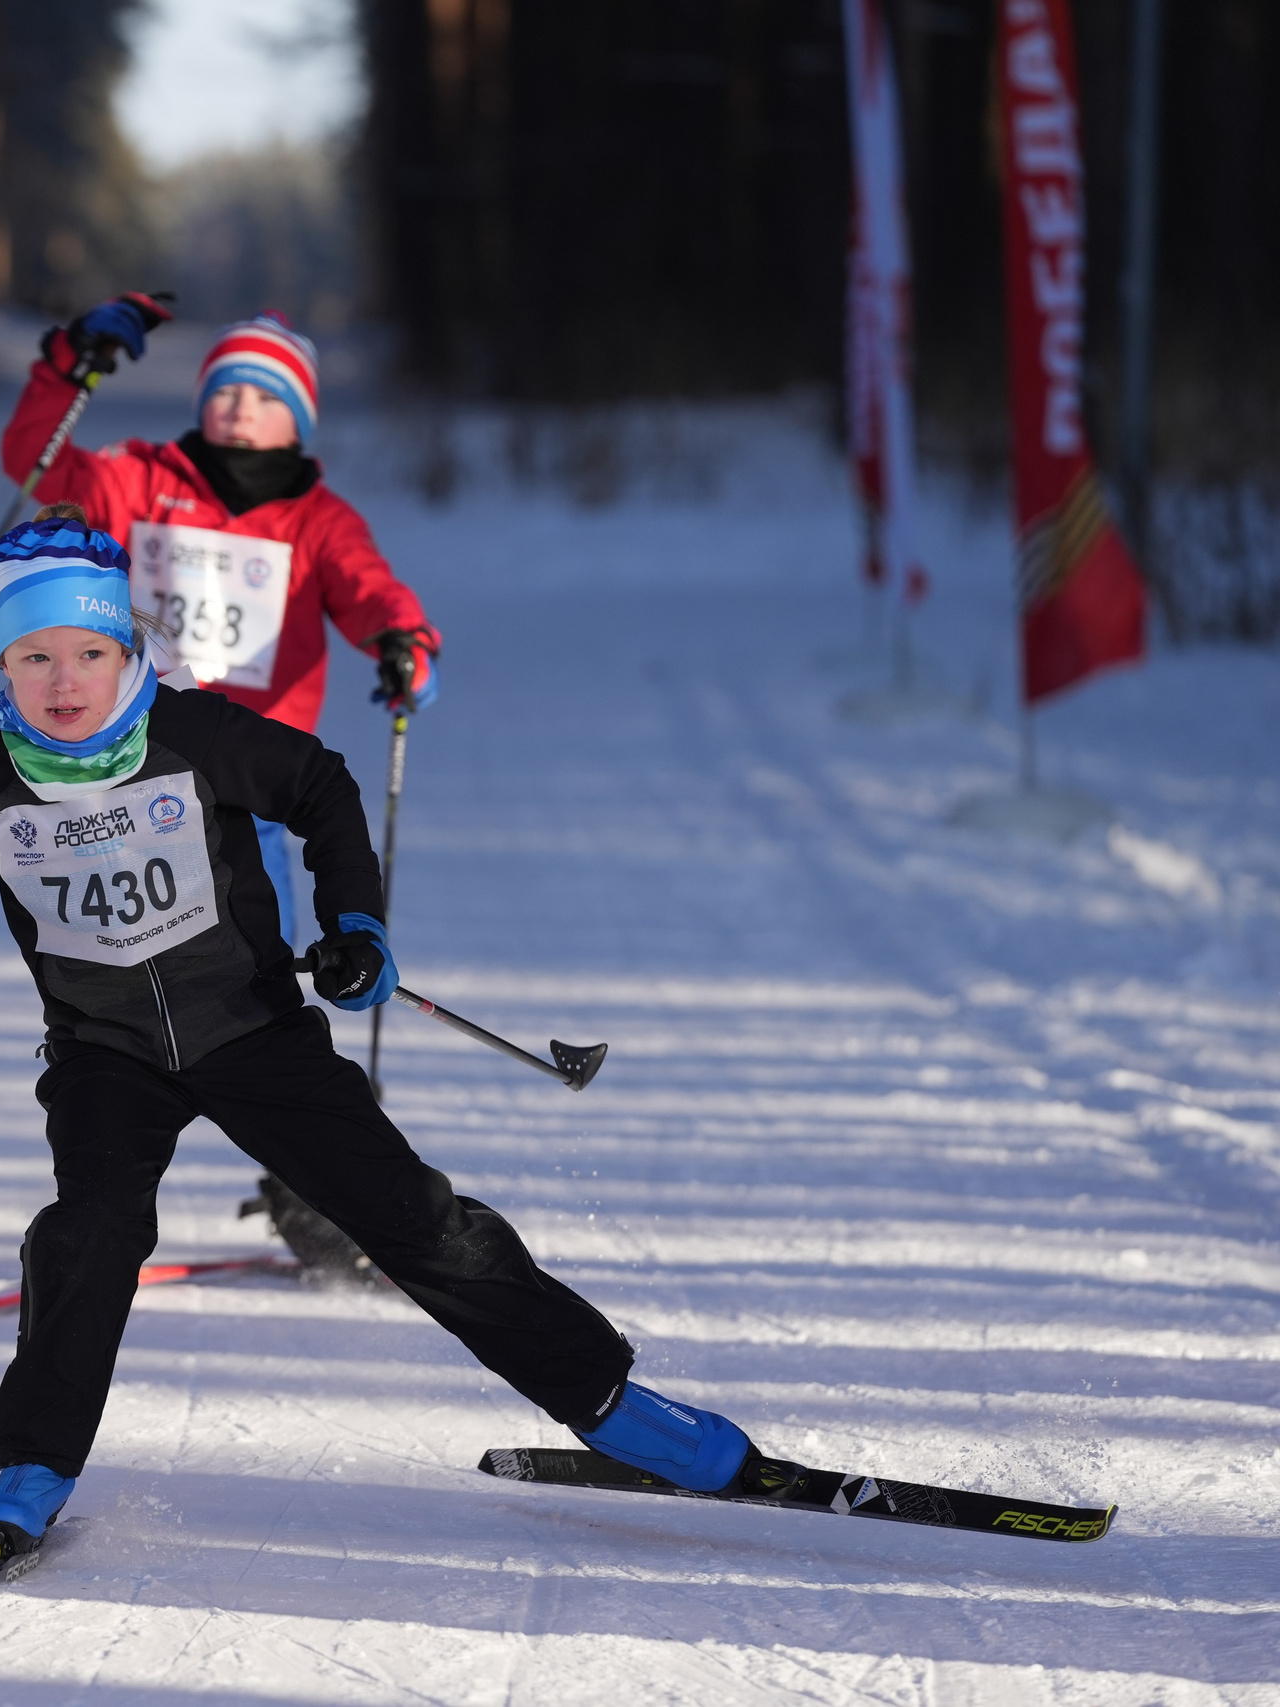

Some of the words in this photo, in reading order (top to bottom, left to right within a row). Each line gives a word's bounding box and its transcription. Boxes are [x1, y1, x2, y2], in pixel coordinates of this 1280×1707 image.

[152, 590, 243, 648] 7358
[54, 819, 136, 848] РОССИИ
[56, 806, 130, 834] ЛЫЖНЯ
[72, 836, 125, 858] 2025
[17, 859, 45, 867] РОССИИ
[40, 857, 177, 927] 7430
[96, 925, 164, 949] СВЕРДЛОВСКАЯ
[166, 905, 205, 930] ОБЛАСТЬ
[992, 1510, 1105, 1537] FISCHER
